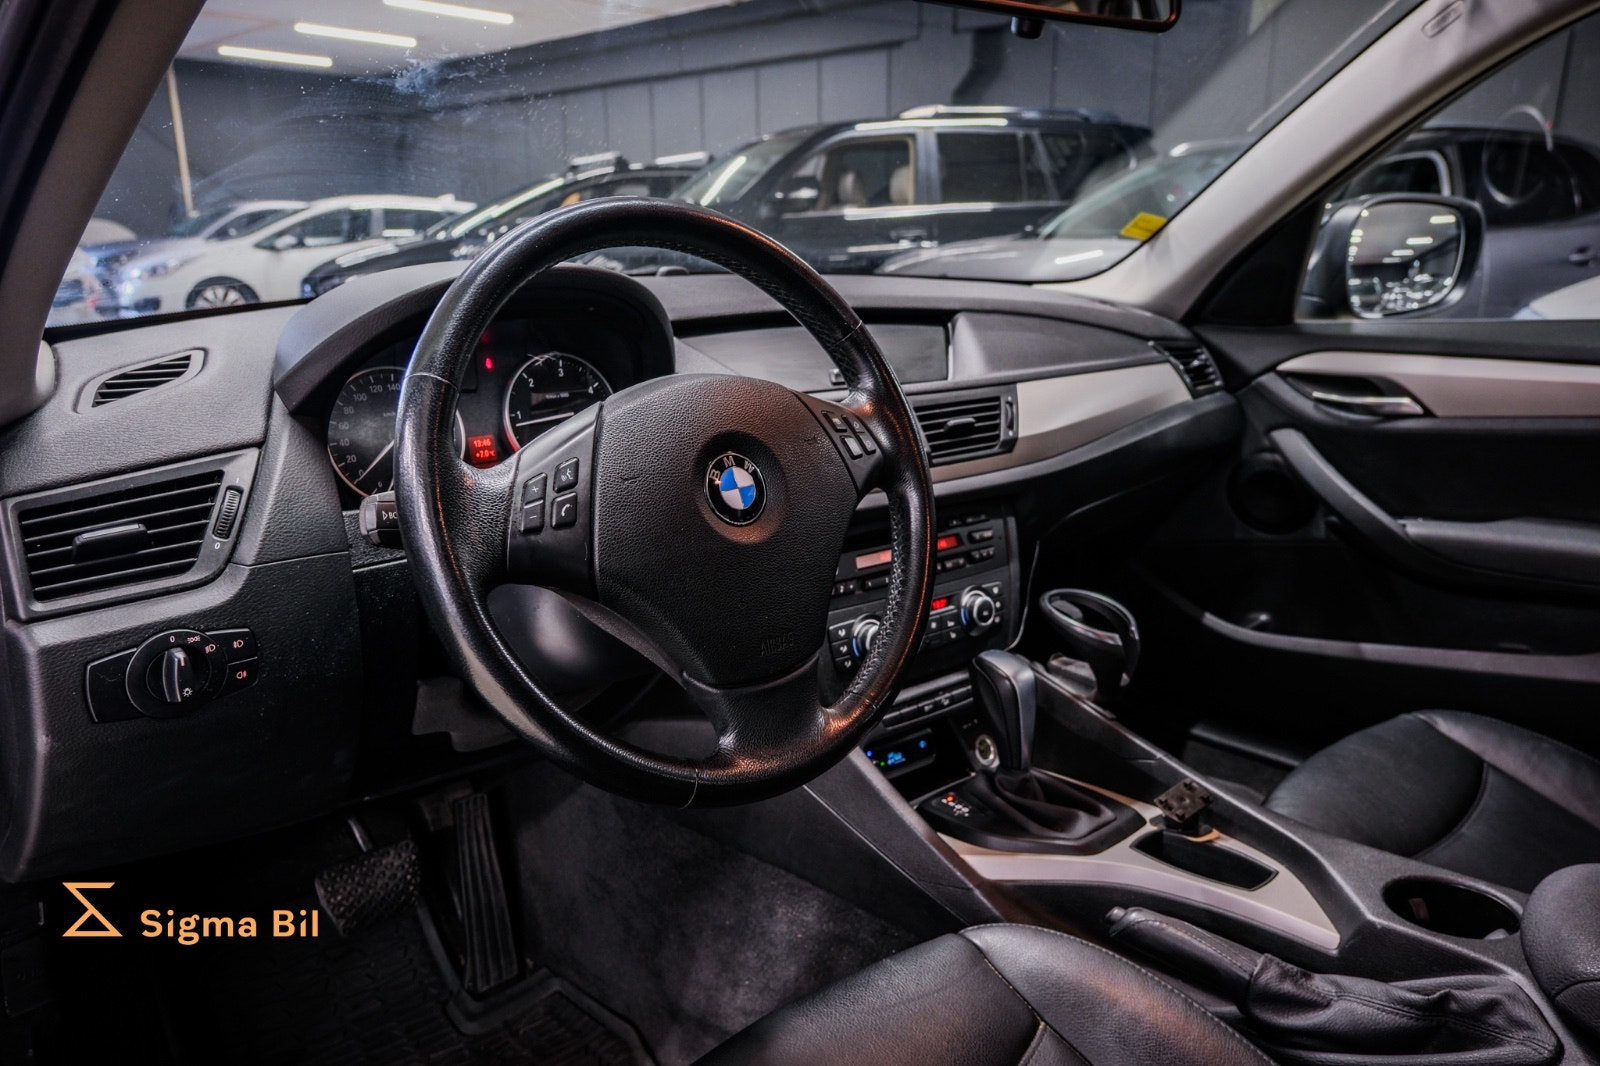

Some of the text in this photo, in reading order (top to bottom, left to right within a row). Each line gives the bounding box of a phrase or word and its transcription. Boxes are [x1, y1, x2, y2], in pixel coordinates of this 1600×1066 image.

[558, 368, 565, 377] 3
[387, 383, 400, 391] 140
[528, 378, 535, 387] 2
[369, 384, 383, 393] 120
[588, 386, 594, 395] 4
[353, 392, 367, 401] 100
[343, 406, 354, 415] 80
[516, 410, 522, 420] 1
[338, 421, 350, 430] 60
[339, 438, 350, 447] 40
[345, 454, 357, 463] 20
[709, 455, 755, 481] BMW
